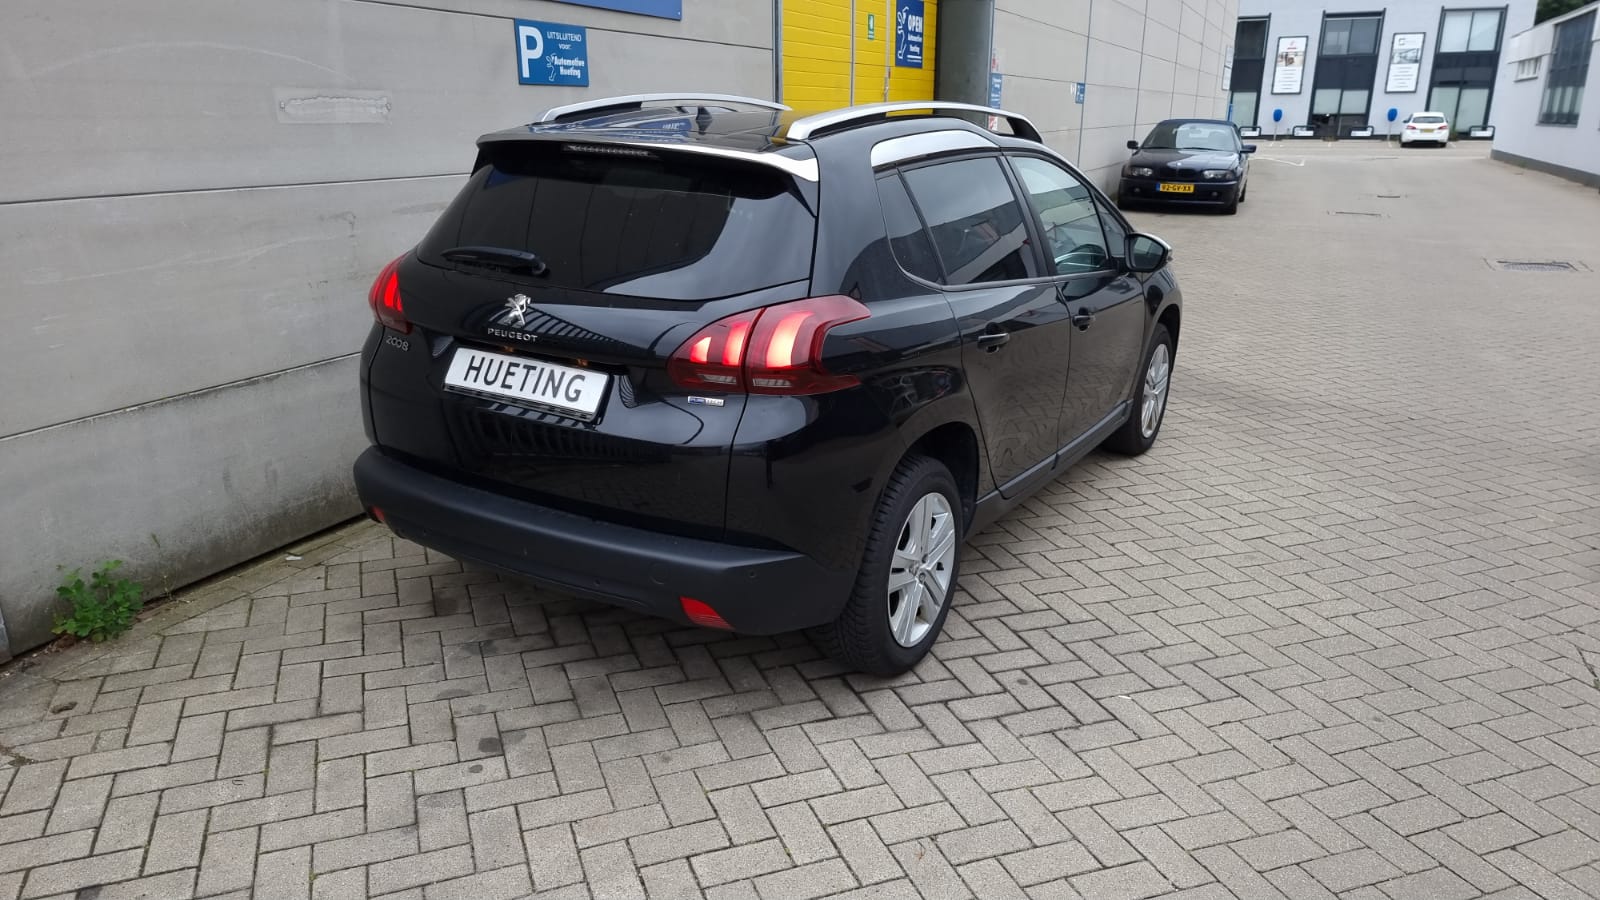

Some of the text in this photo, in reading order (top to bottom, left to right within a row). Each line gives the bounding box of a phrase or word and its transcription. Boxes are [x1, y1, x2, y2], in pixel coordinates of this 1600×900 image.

[907, 14, 923, 33] OPEN
[546, 31, 582, 42] UITSLUITEND
[519, 25, 543, 78] P
[554, 55, 585, 67] Automotive
[487, 327, 538, 342] PEUGEOT
[386, 335, 409, 352] 2008
[463, 355, 586, 402] HUETING
